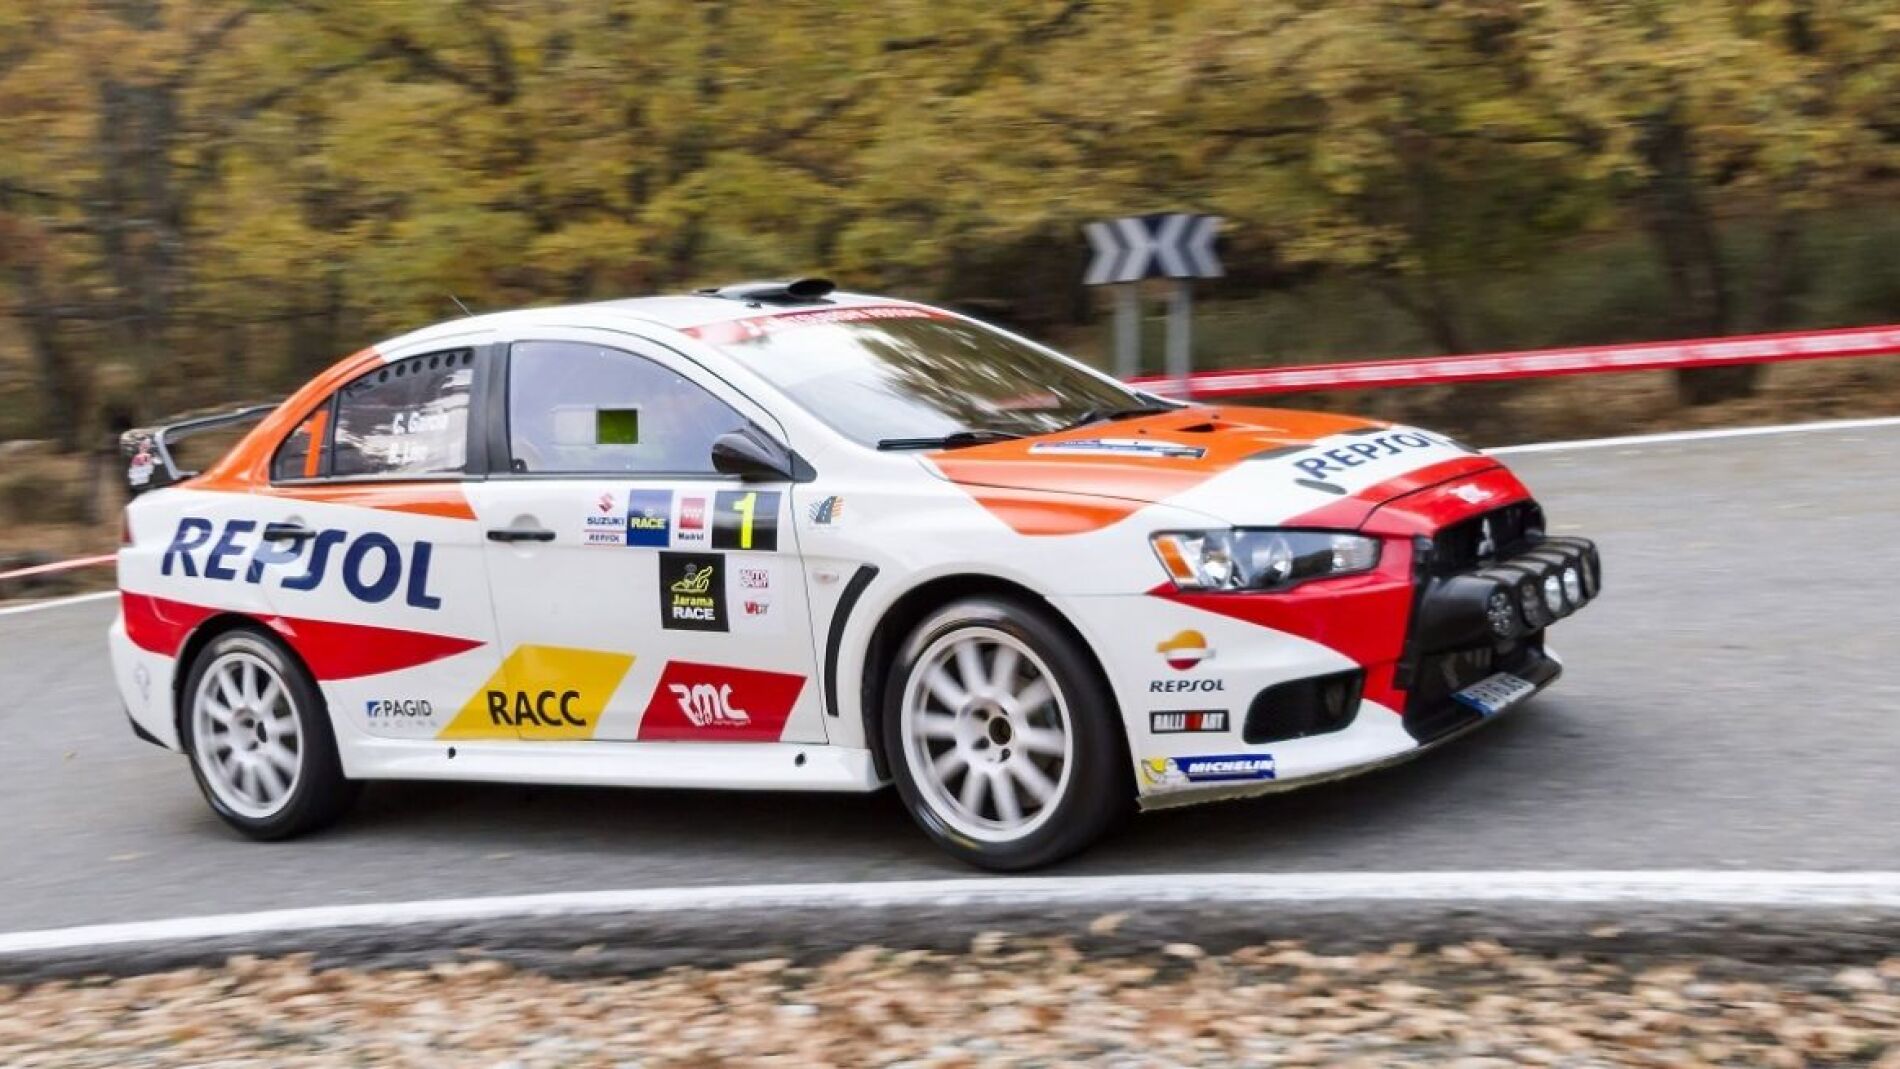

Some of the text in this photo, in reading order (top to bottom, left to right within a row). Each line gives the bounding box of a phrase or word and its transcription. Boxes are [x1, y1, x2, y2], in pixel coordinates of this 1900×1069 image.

[303, 410, 329, 478] 1
[587, 516, 624, 525] SUZUKI
[631, 516, 665, 529] RACE
[733, 492, 757, 549] 1
[678, 532, 704, 541] Madrid
[161, 517, 441, 610] REPSOL
[673, 593, 713, 606] Jarama
[673, 606, 715, 620] RACE
[1150, 679, 1225, 692] REPSOL
[384, 699, 432, 717] PAGID
[488, 689, 587, 727] RACC
[1189, 759, 1275, 774] MICHELIN
